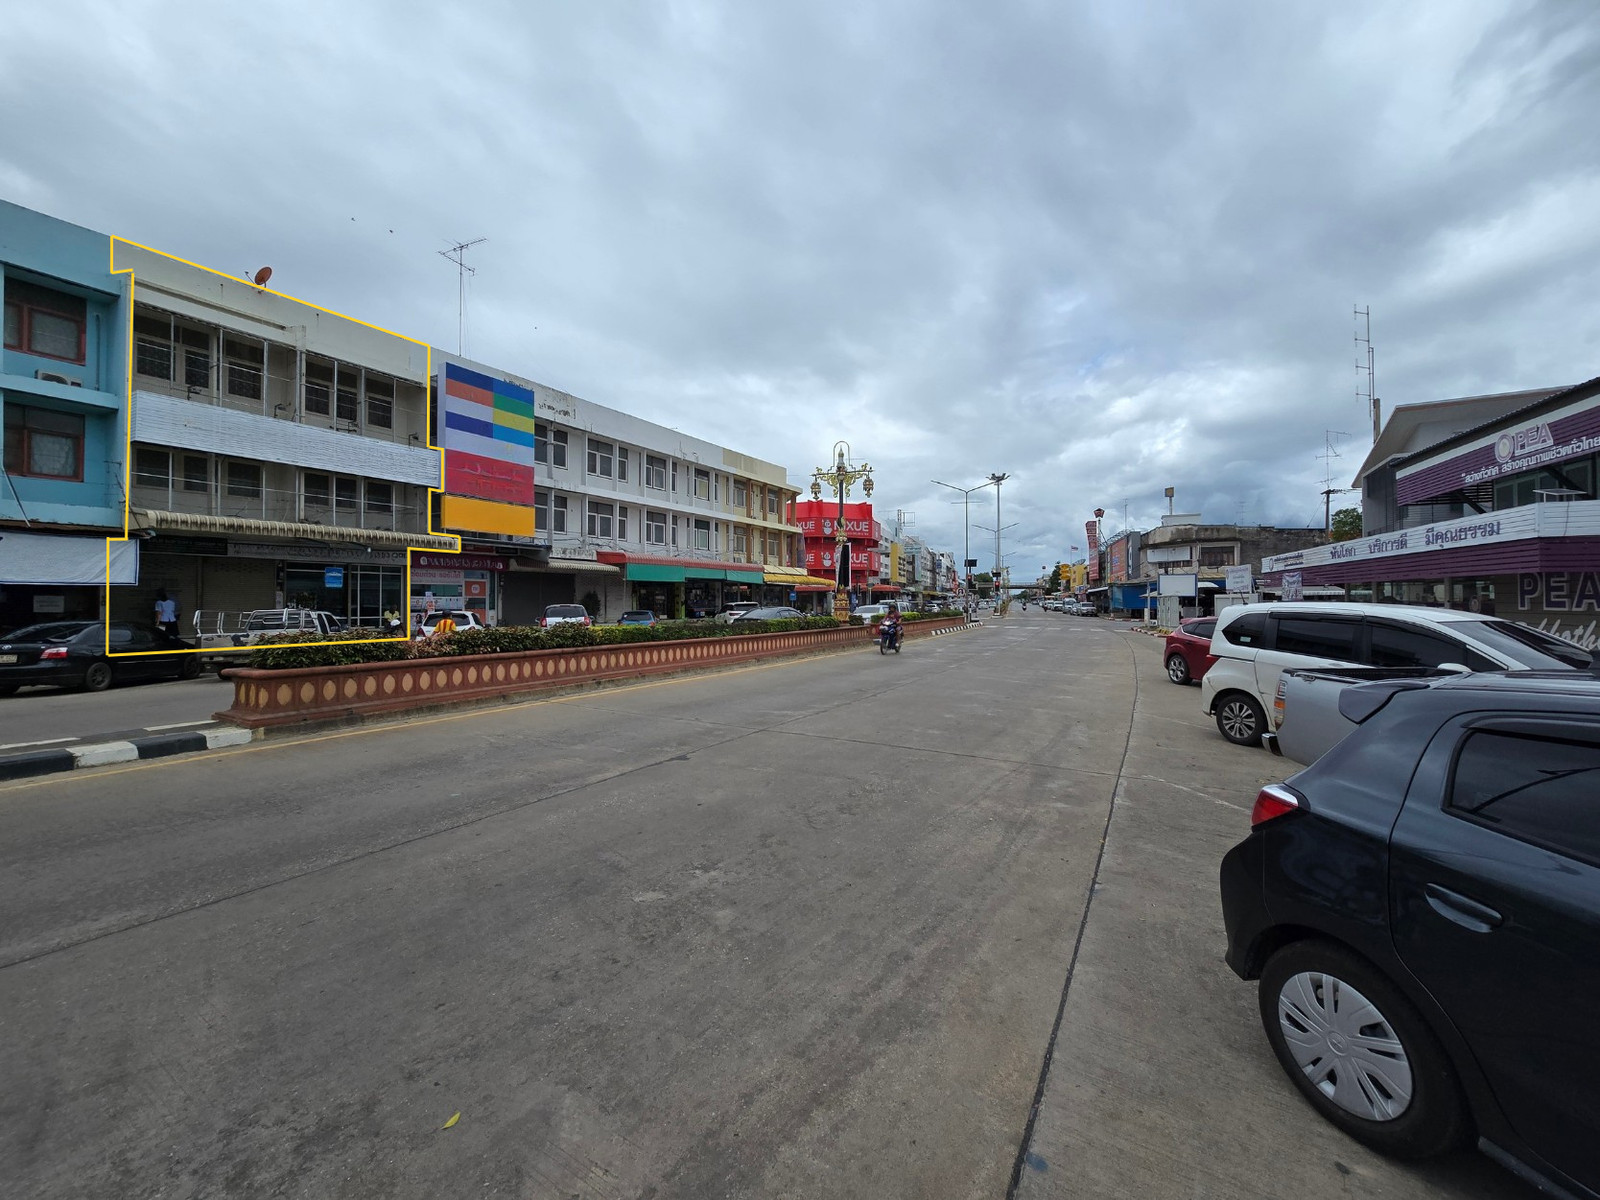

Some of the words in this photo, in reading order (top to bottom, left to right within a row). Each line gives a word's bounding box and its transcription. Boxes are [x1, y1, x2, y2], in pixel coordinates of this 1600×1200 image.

[1514, 421, 1554, 456] PEA
[787, 521, 815, 530] XUE
[1368, 532, 1408, 554] บริการดี
[1424, 521, 1501, 549] มีคุณธรรม
[1517, 571, 1600, 612] PEA
